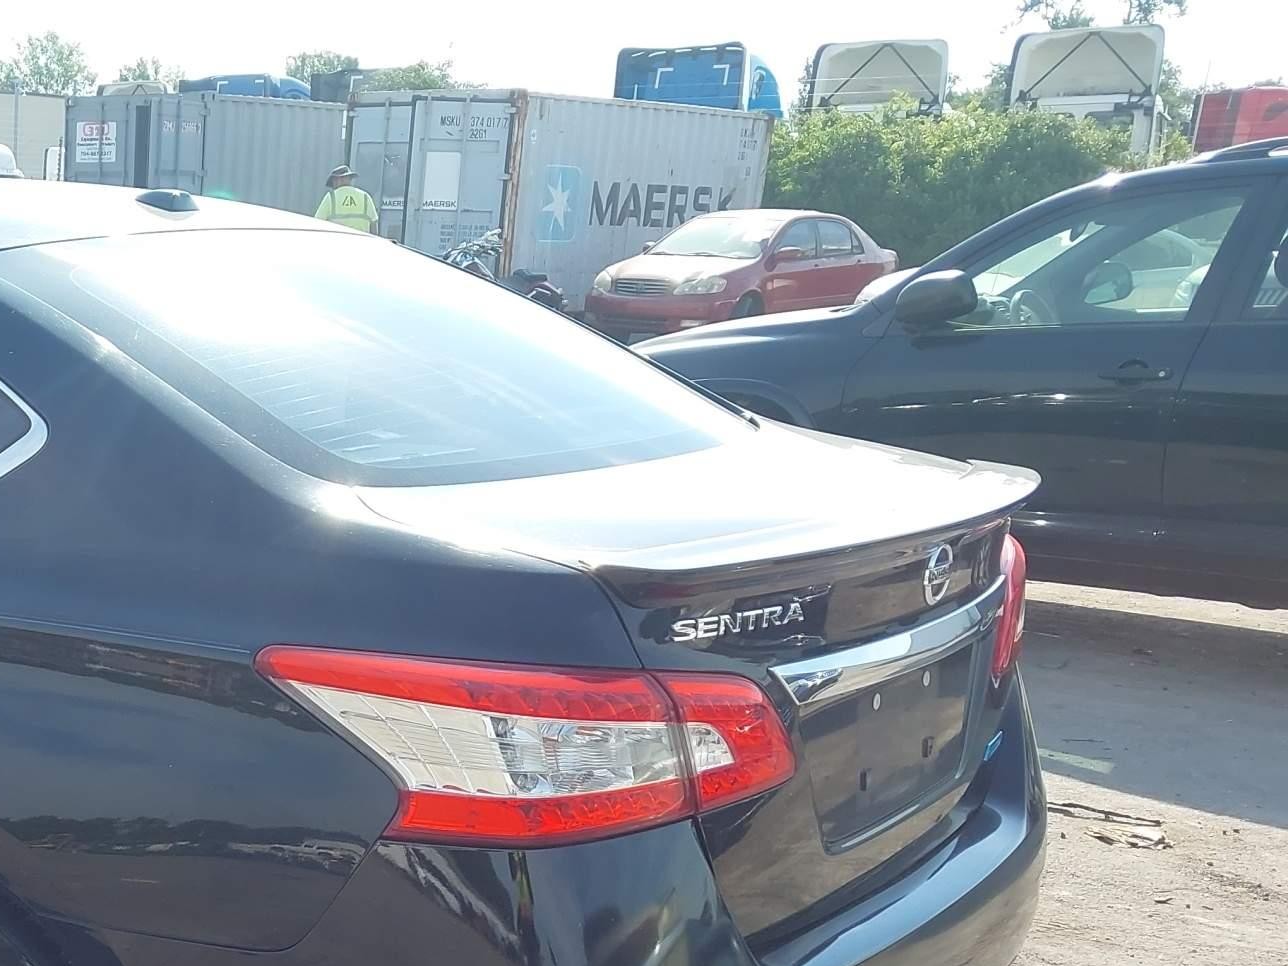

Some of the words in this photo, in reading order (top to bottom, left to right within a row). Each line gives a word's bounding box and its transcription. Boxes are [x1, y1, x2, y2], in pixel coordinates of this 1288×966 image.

[440, 115, 461, 127] MSKU
[471, 116, 484, 128] 374
[382, 199, 405, 207] MAERS
[422, 200, 456, 208] MAERSK
[589, 180, 737, 228] MAERSK
[671, 602, 804, 642] SENTRA
